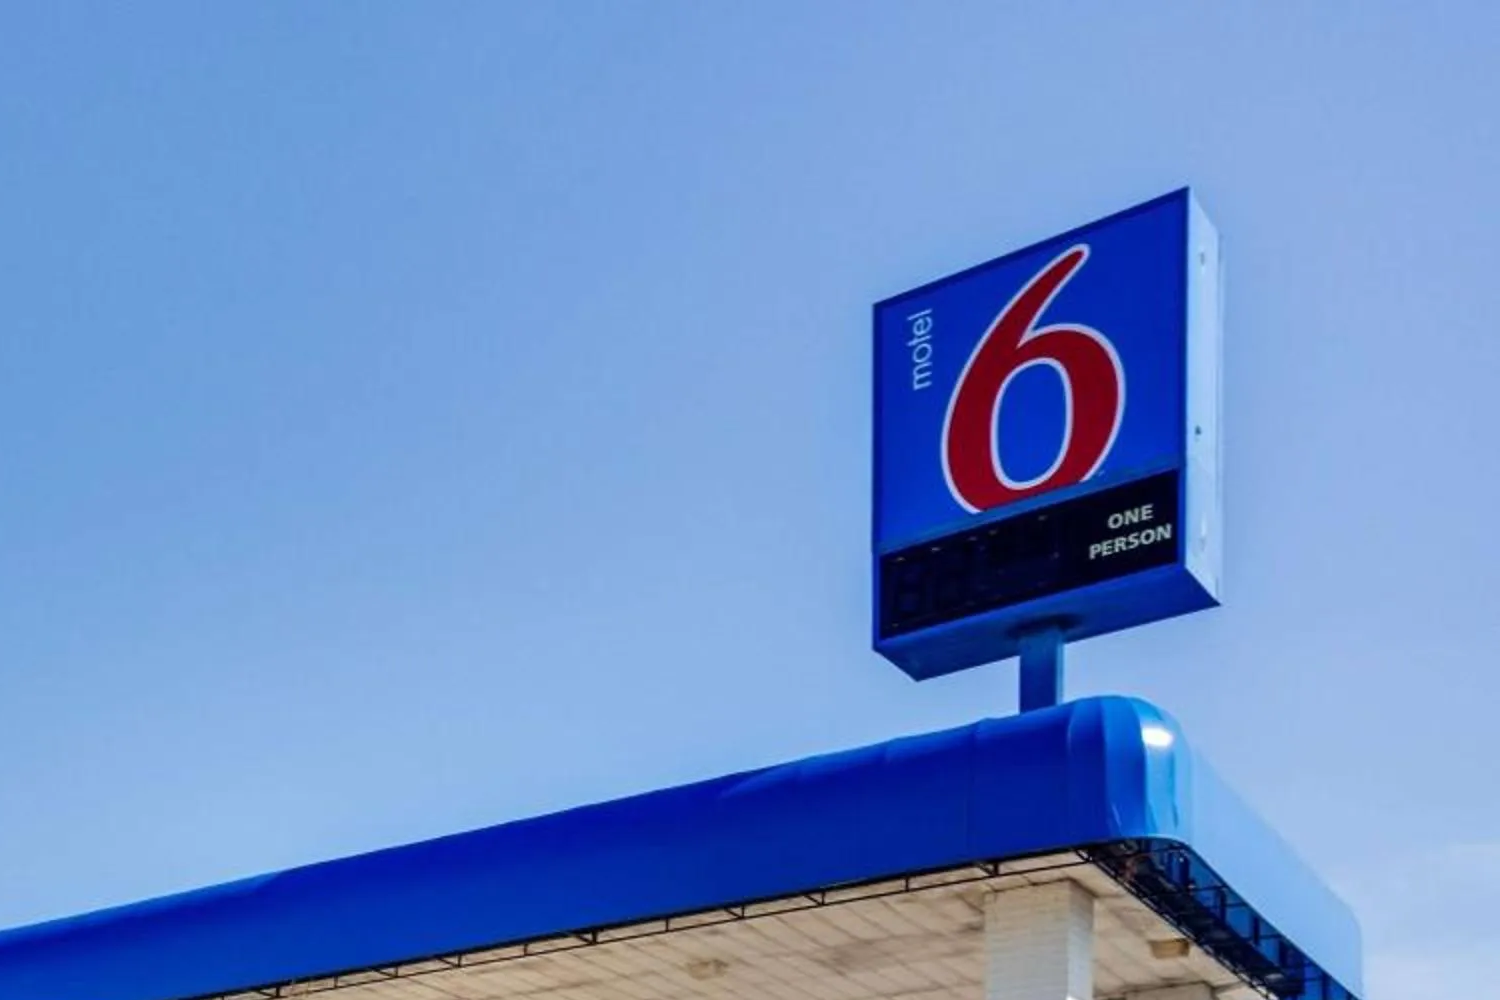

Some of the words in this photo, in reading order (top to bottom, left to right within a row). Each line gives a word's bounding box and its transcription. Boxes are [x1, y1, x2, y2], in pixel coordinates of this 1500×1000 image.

[906, 308, 933, 391] motel
[941, 243, 1126, 514] 6
[1089, 522, 1173, 560] PERSON
[1107, 503, 1155, 529] ONE
